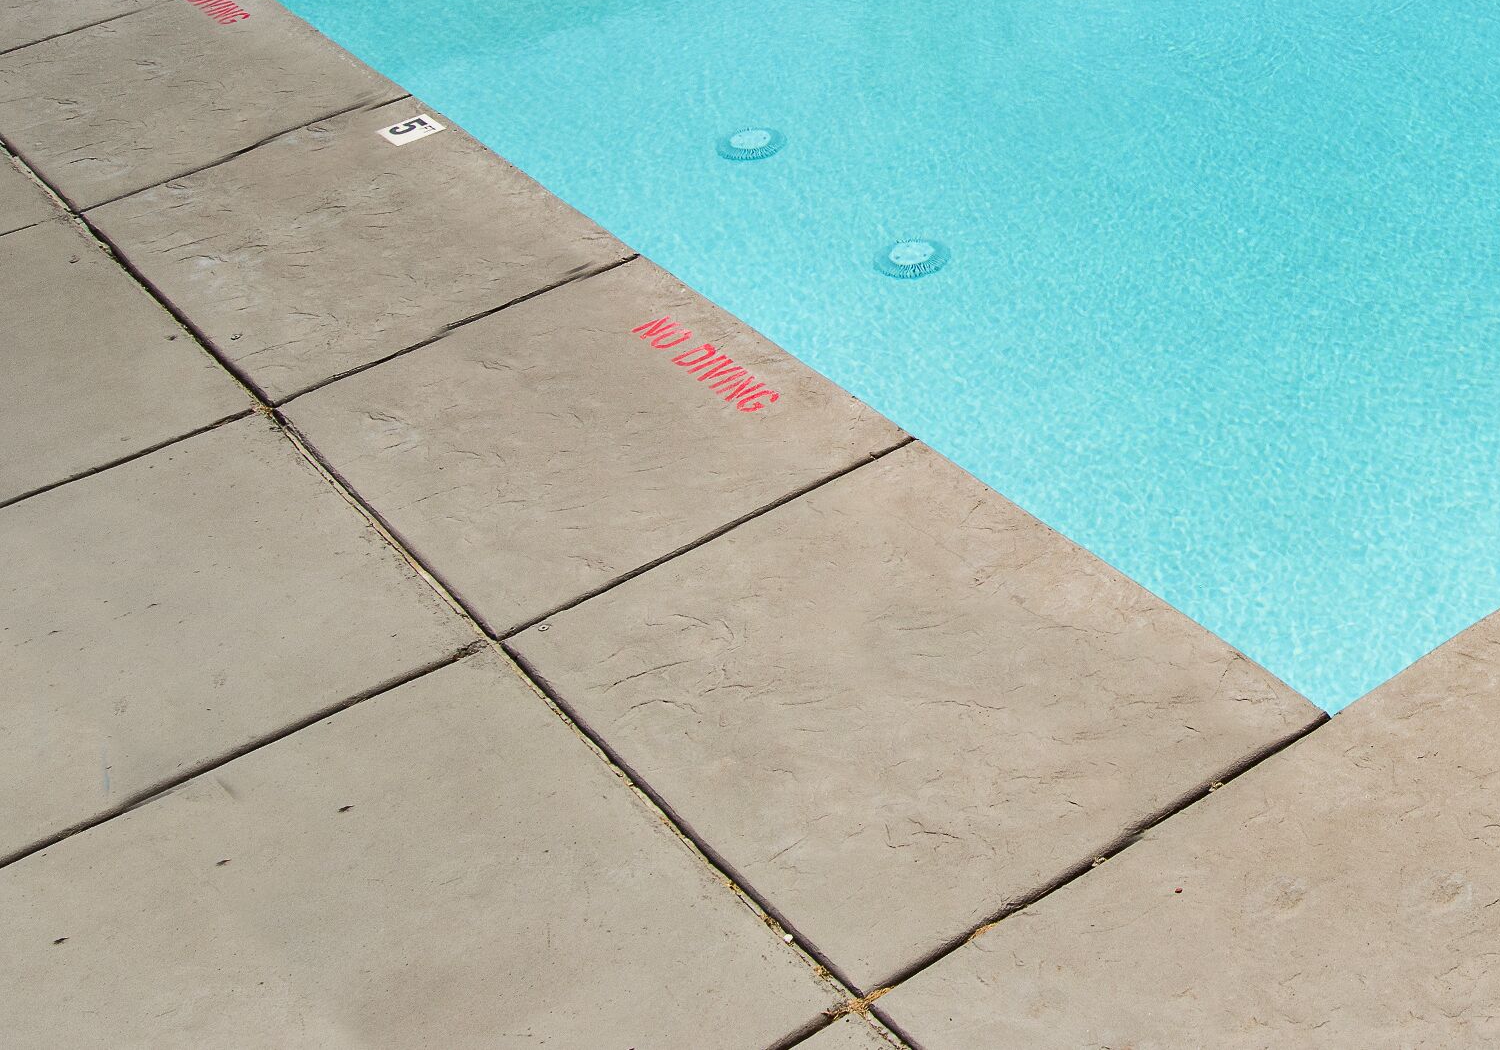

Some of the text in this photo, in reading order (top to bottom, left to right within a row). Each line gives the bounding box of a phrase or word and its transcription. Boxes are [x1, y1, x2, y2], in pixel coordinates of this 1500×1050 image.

[388, 118, 428, 136] 5
[631, 314, 781, 413] NO DIVING
